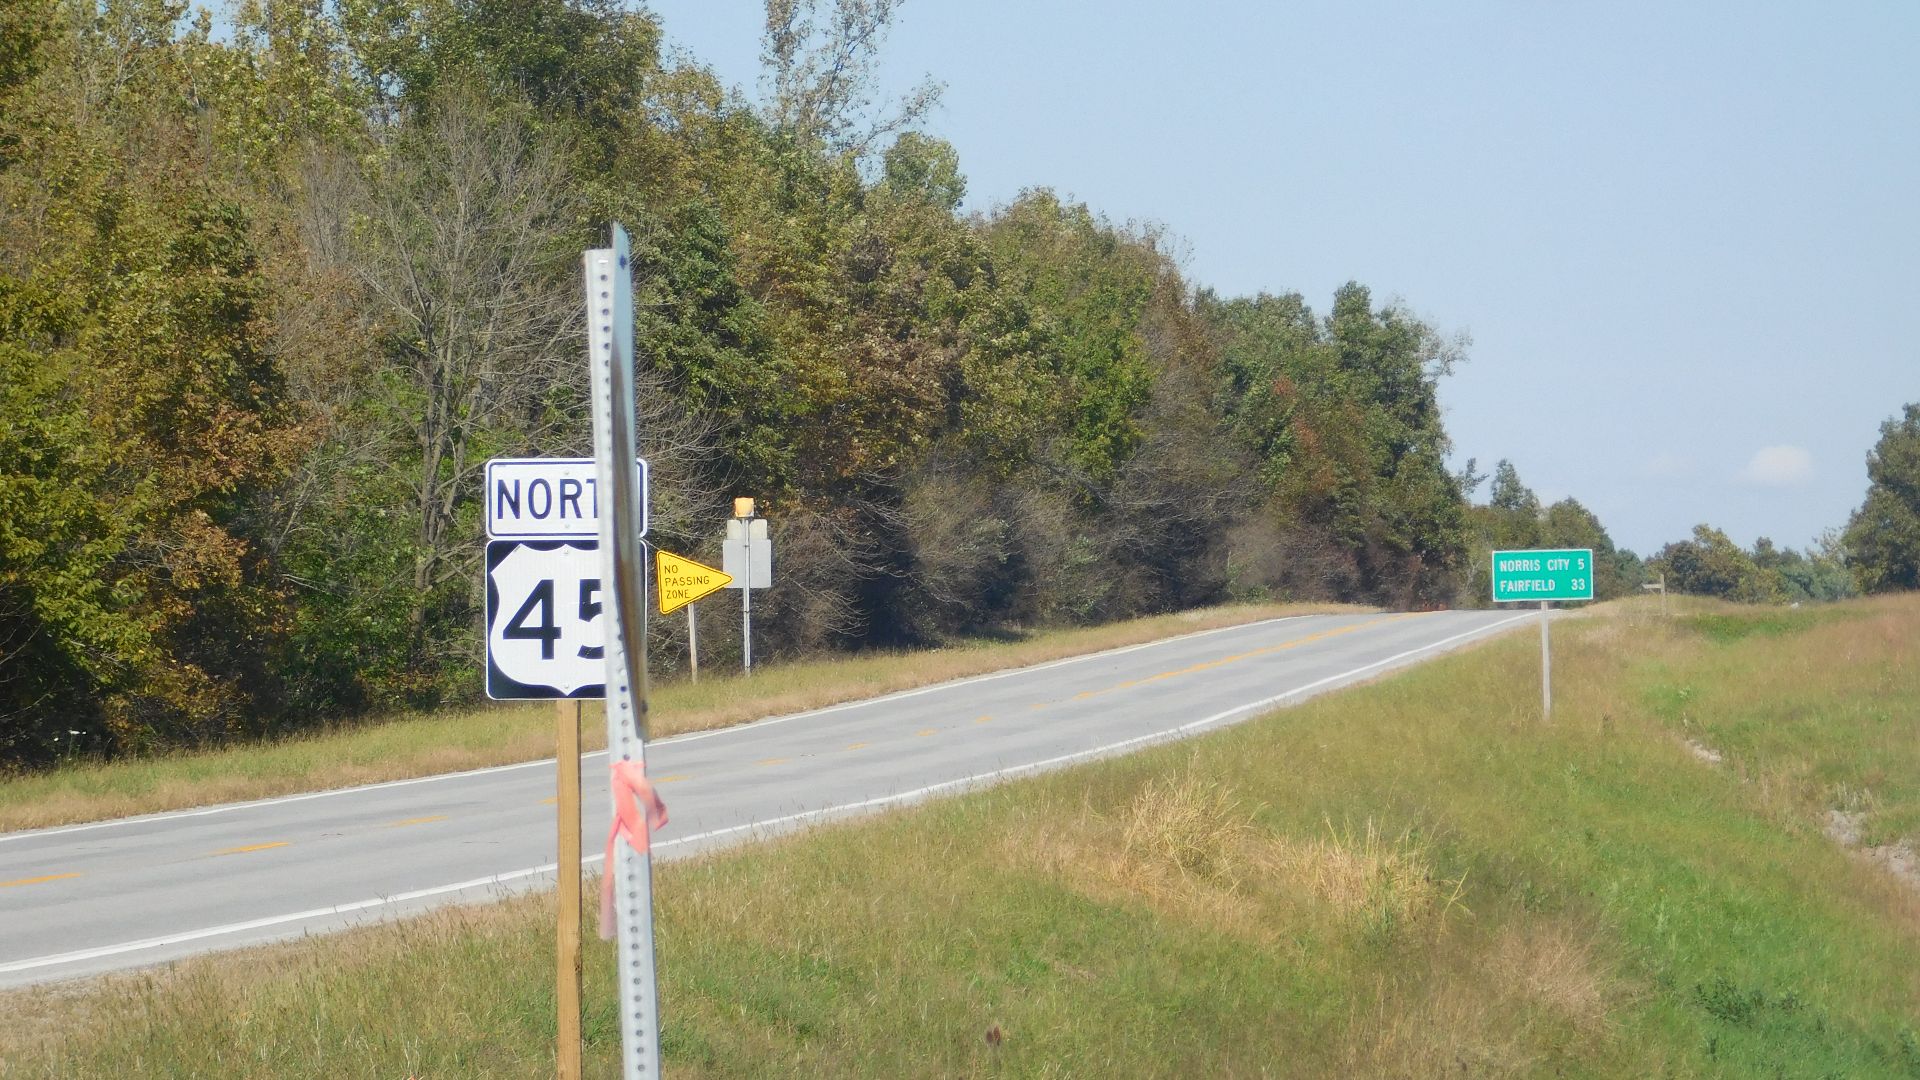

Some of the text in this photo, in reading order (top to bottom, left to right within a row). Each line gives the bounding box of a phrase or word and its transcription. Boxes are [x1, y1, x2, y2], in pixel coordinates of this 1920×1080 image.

[497, 478, 599, 520] NORT
[664, 565, 678, 574] NO
[1500, 558, 1585, 572] NORRIS CITY 5
[665, 575, 710, 587] PASSING
[1500, 578, 1585, 592] FAIRFIELD 33
[666, 589, 691, 600] ZONE
